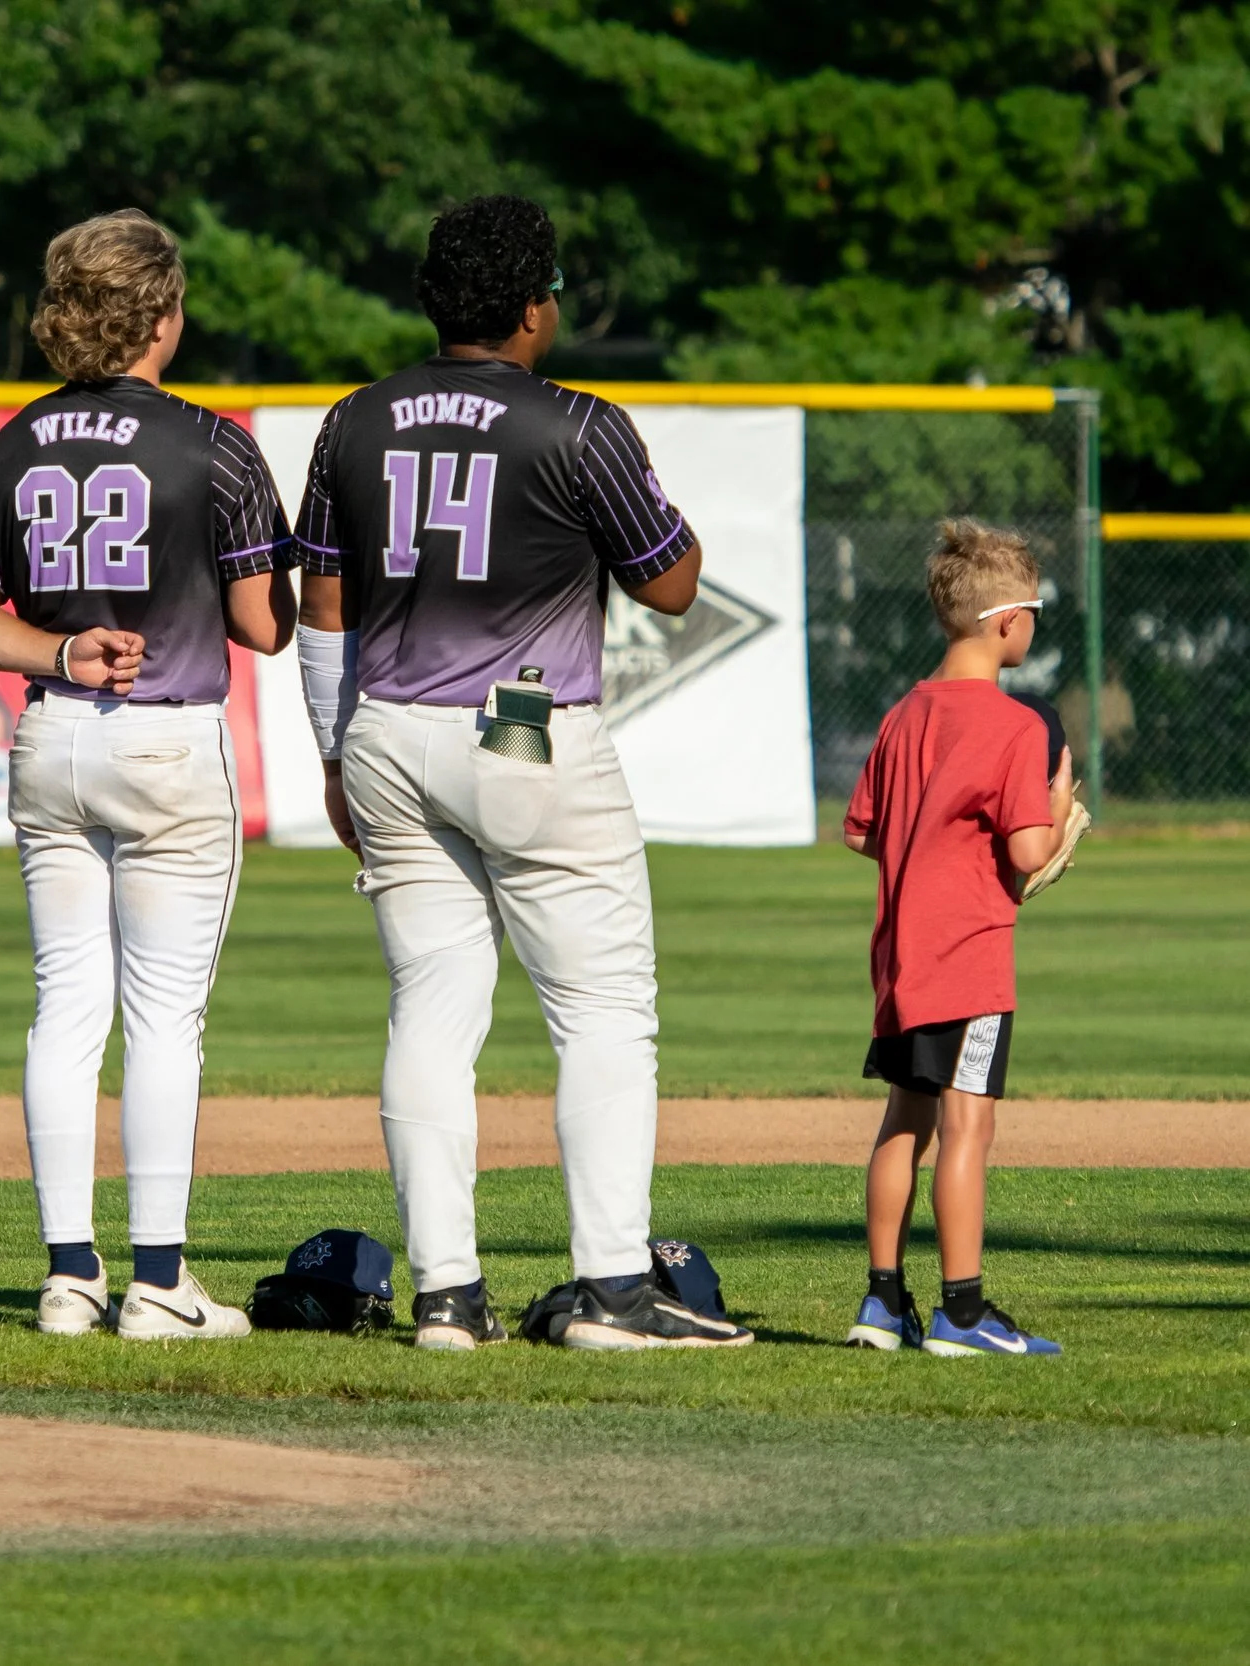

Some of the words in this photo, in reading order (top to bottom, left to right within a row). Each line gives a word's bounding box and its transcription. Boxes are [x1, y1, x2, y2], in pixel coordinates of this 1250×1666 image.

[30, 411, 140, 446] WILLS
[390, 392, 508, 432] DOMEY
[15, 464, 151, 593] 22
[383, 450, 498, 581] 14
[961, 1015, 998, 1077] SSi
